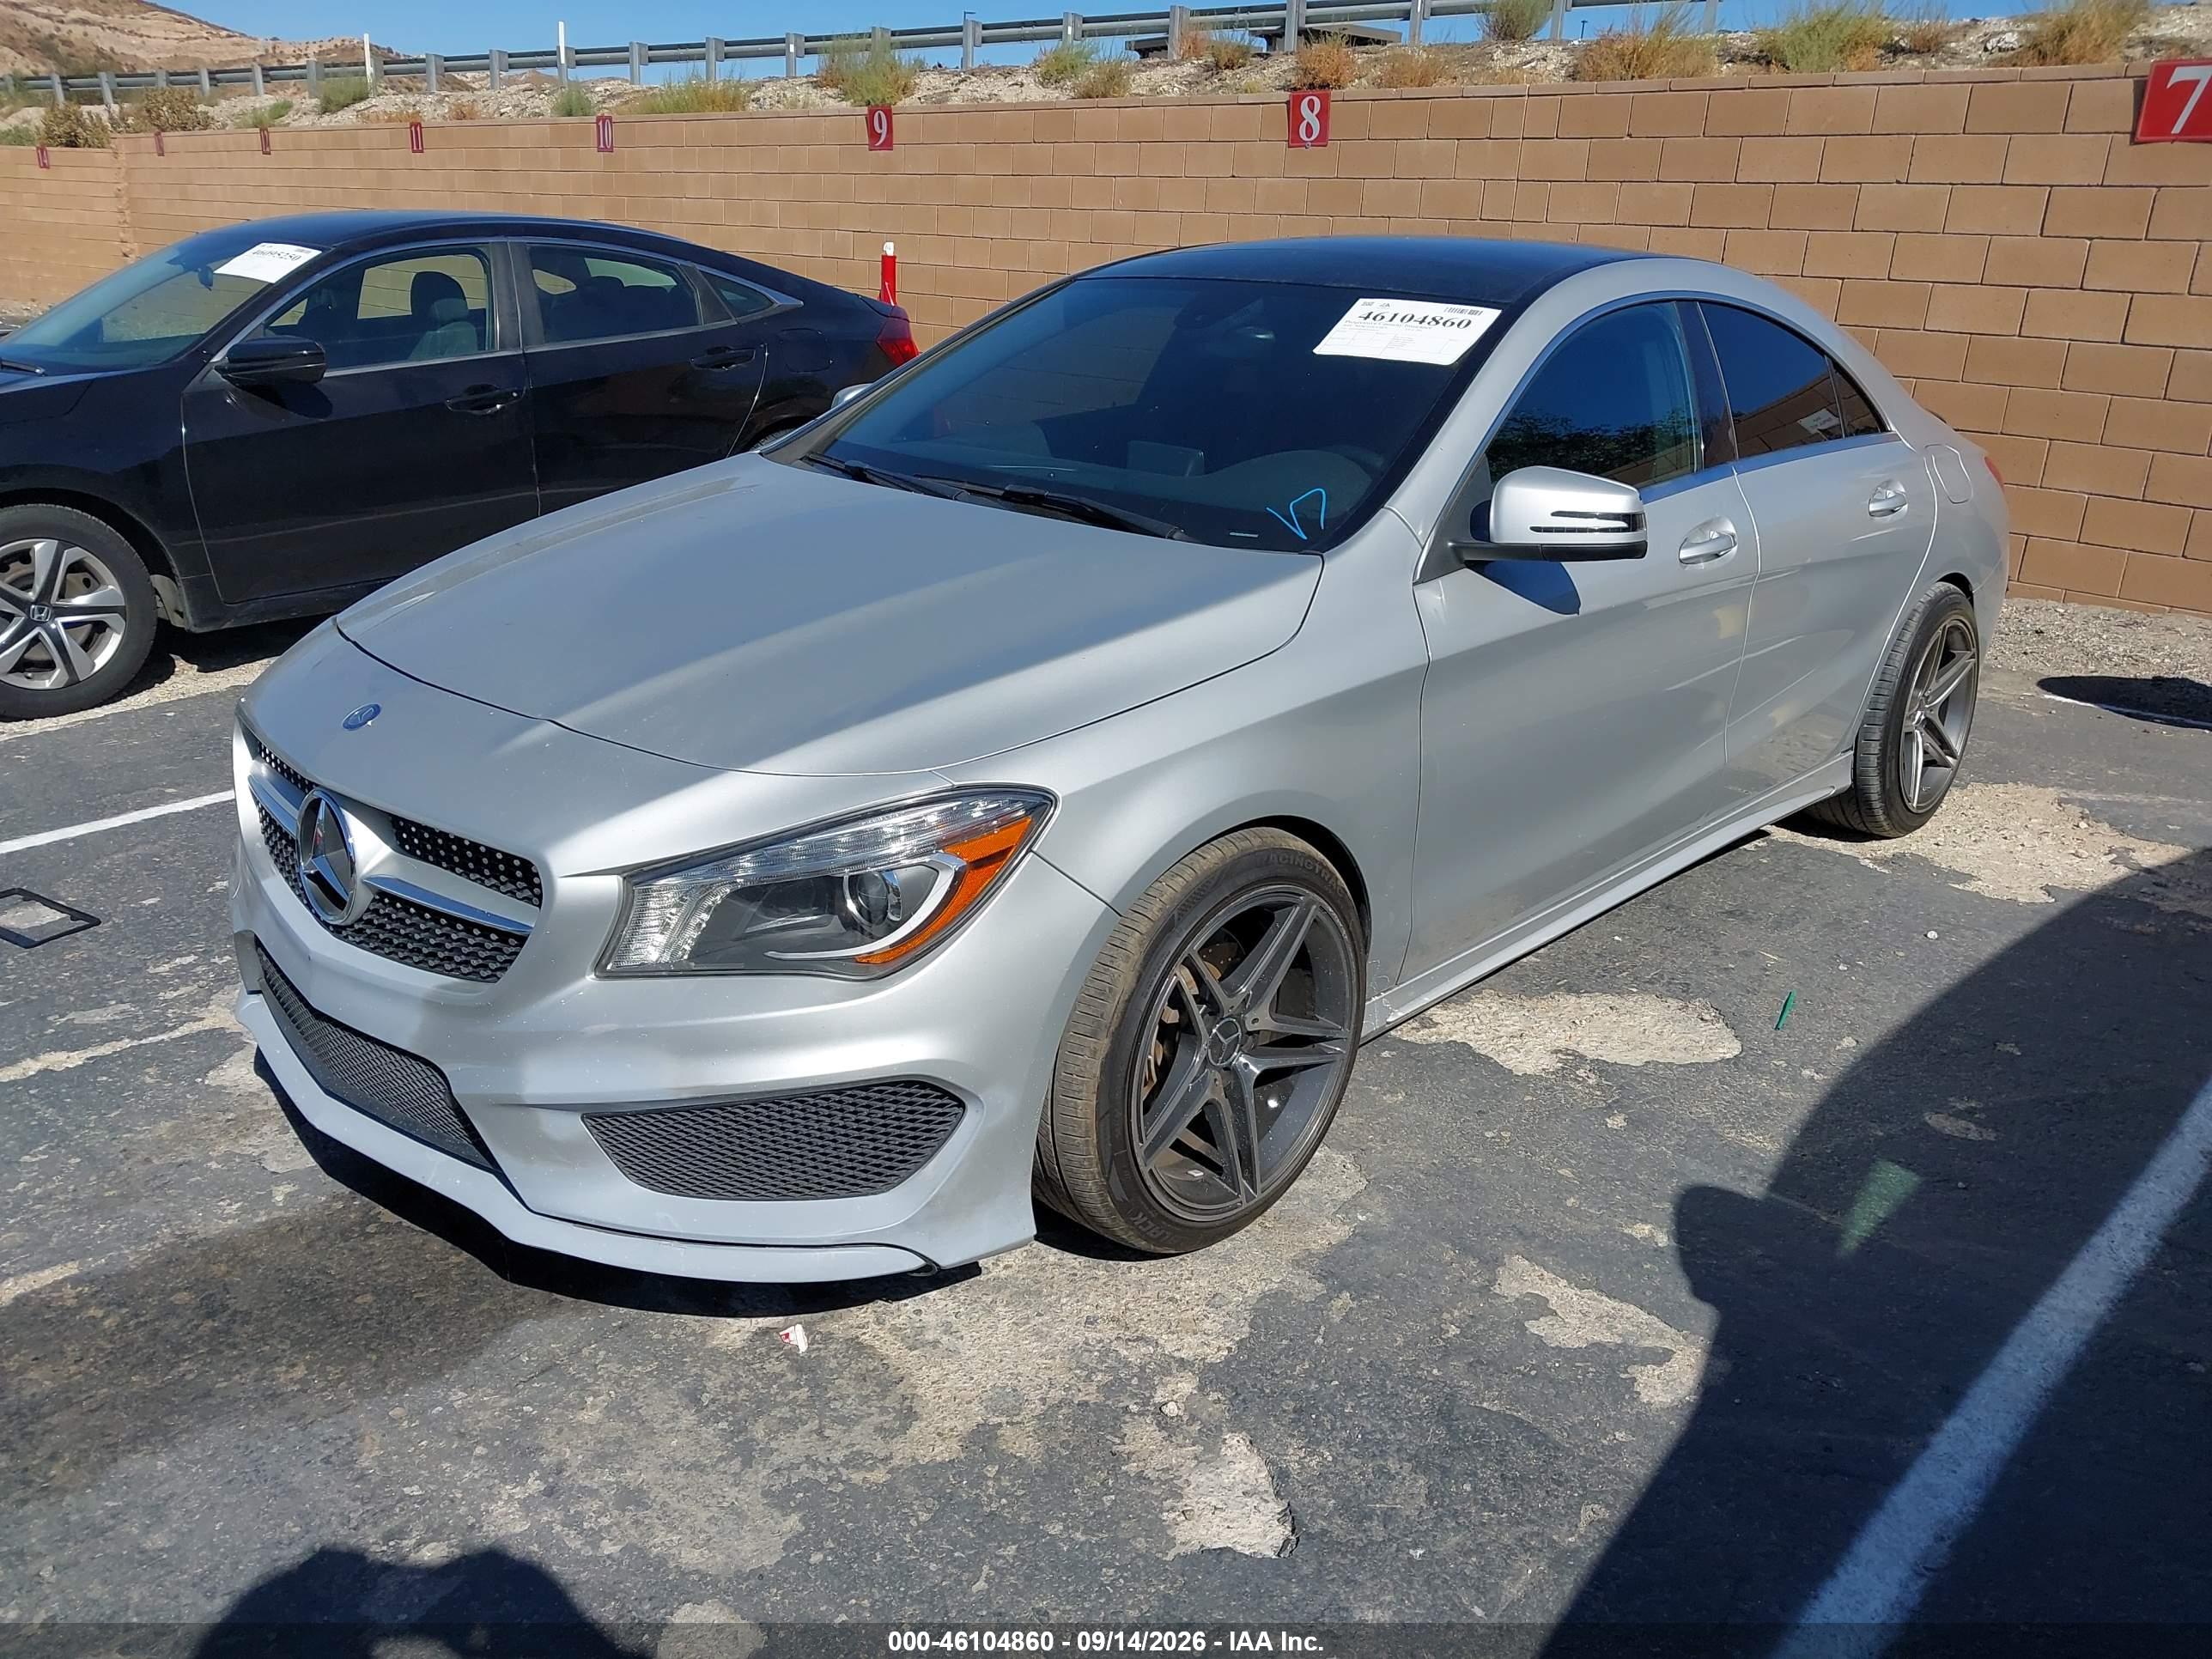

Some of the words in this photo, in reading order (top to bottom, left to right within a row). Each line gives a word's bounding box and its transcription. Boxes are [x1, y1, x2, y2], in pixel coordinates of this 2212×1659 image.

[2166, 65, 2212, 134] 7
[599, 118, 612, 149] 10
[873, 110, 888, 146] 9
[1298, 95, 1321, 142] 8
[411, 125, 422, 150] 11
[1358, 311, 1472, 329] 46104860
